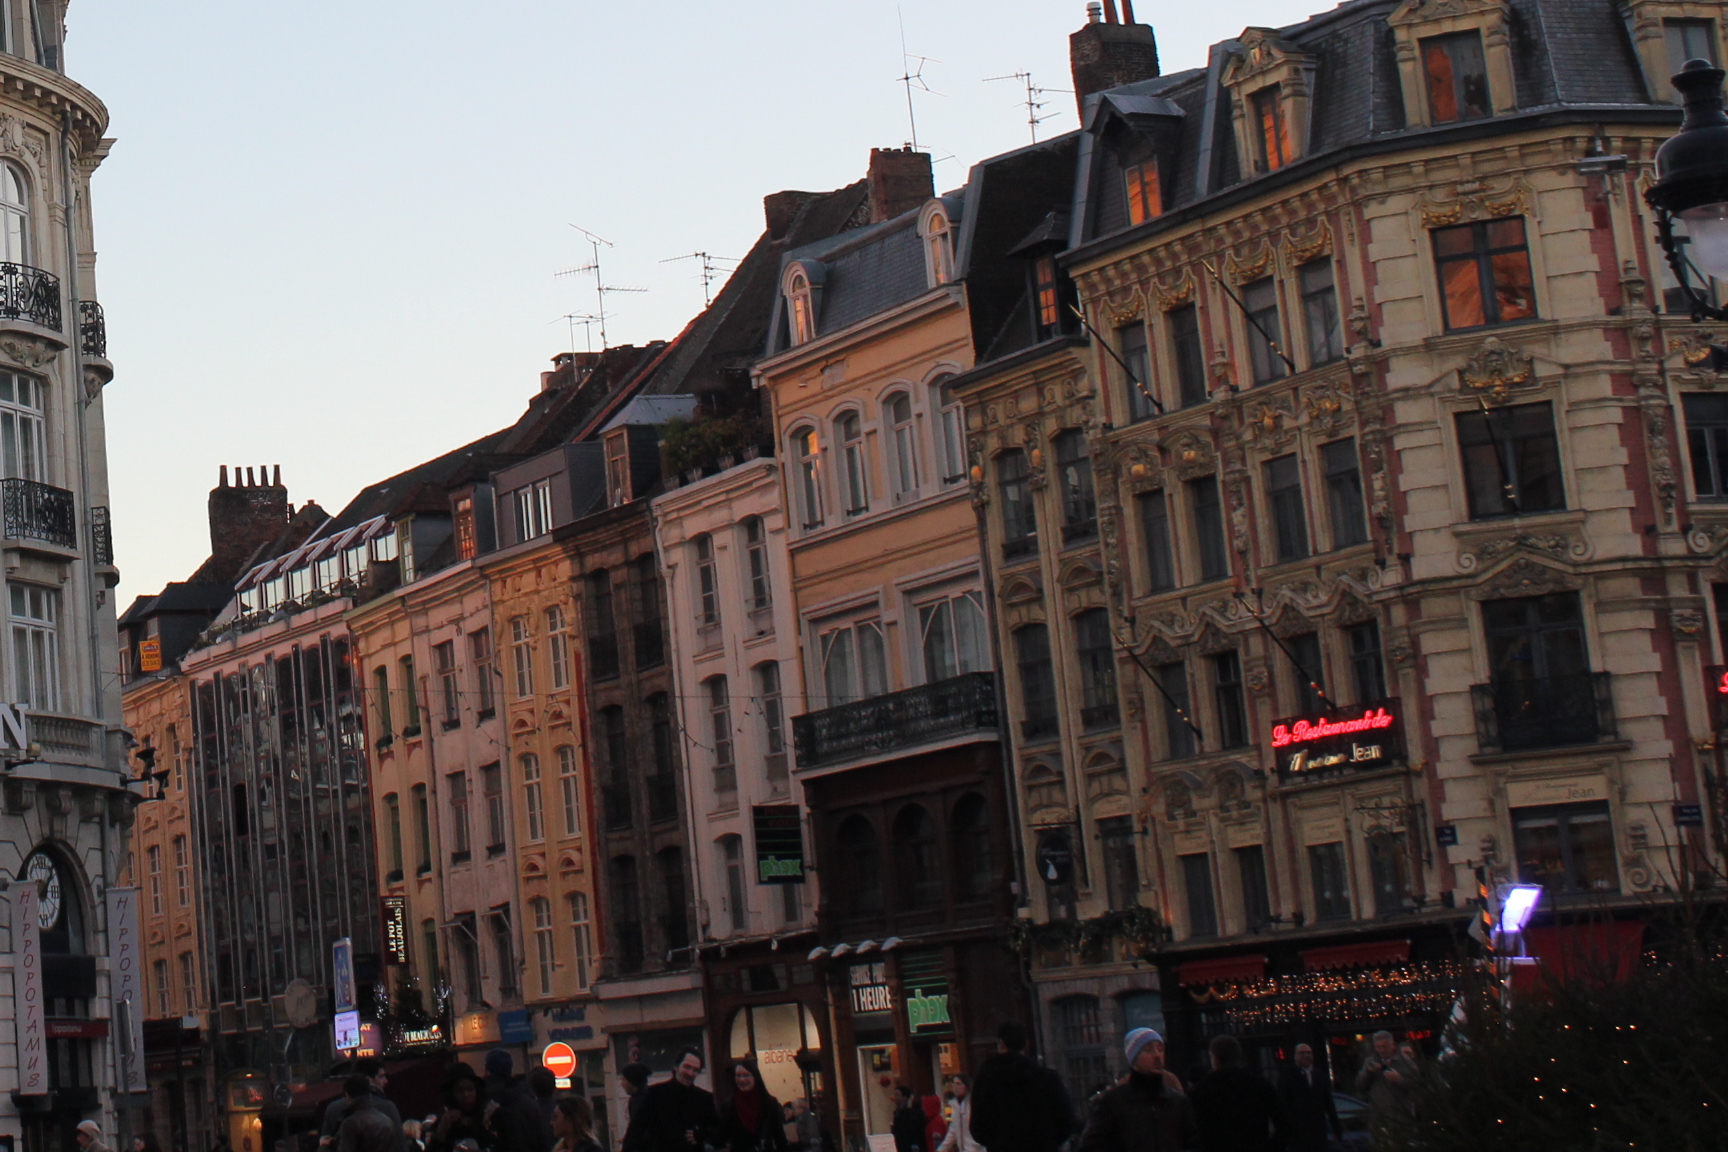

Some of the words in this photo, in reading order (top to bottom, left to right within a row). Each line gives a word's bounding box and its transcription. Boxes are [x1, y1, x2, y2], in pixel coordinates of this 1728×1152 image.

[1292, 709, 1372, 742] Restaurant
[1350, 743, 1382, 763] Jean
[387, 919, 395, 938] POT
[394, 907, 406, 963] BEAUJOLAIS
[389, 939, 397, 952] LE
[19, 890, 40, 1088] HIPPOPOTAMUS
[859, 985, 892, 1011] HEURE
[343, 1048, 375, 1058] VNTE
